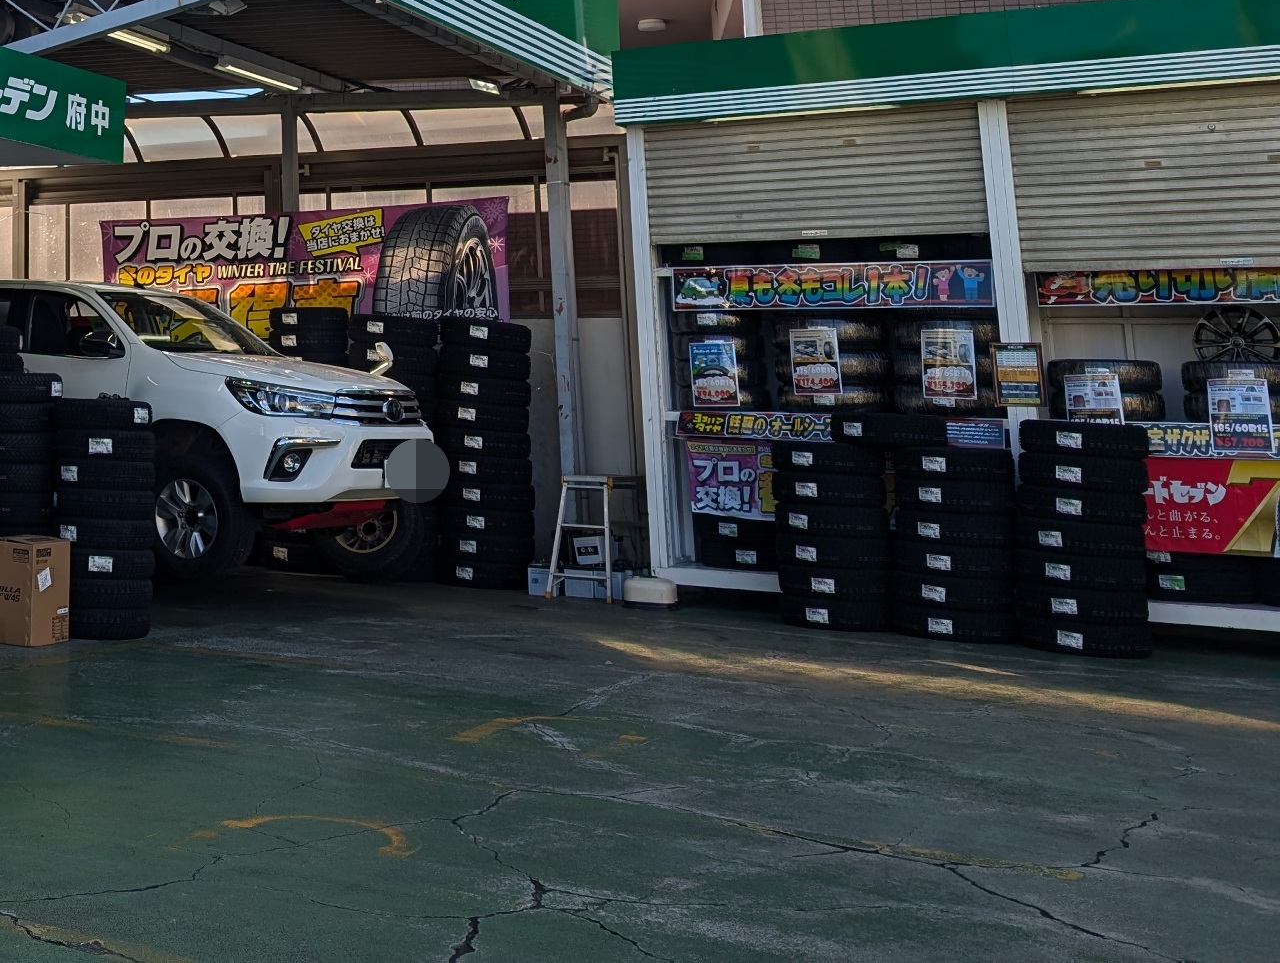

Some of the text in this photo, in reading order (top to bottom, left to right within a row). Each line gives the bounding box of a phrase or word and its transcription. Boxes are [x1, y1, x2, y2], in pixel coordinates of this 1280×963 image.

[66, 93, 110, 136] 府中
[306, 225, 385, 252] 当店におまかせ!
[311, 214, 377, 238] タイヤ交換は
[114, 216, 290, 264] プロの交換!
[118, 264, 212, 286] 冬のタイヤ
[217, 257, 363, 279] WINTER TIRE FESTIVAL
[1213, 423, 1268, 433] 185/60R15
[692, 457, 756, 483] プロの
[695, 486, 752, 511] 交換!
